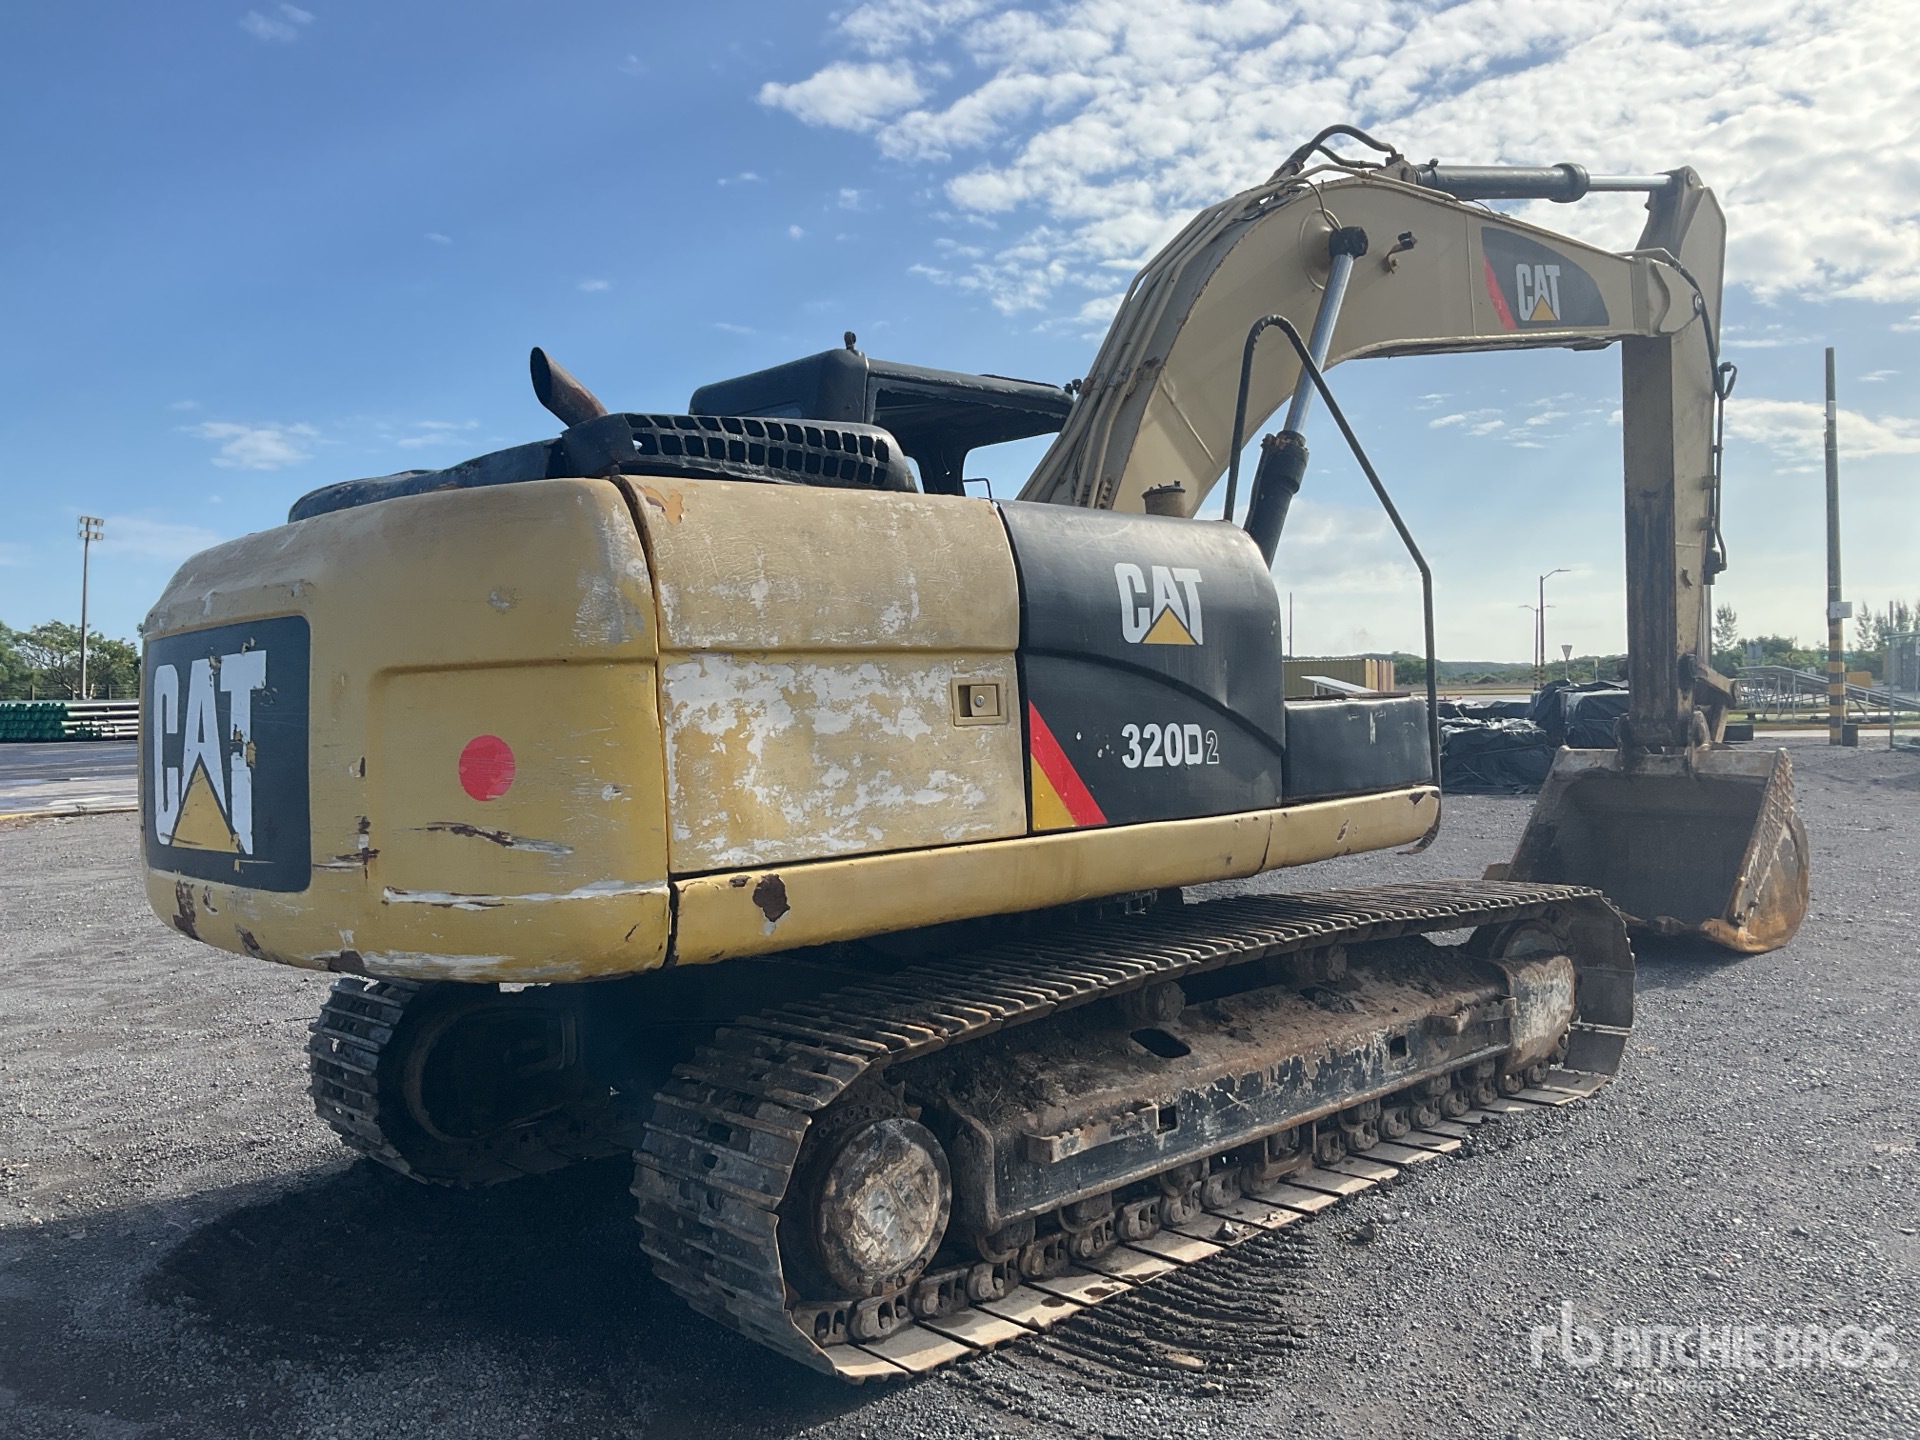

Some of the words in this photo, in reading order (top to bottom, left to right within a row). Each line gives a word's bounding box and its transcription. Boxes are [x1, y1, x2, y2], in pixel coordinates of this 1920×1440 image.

[1515, 263, 1561, 321] CAT
[1114, 562, 1204, 646] CAT
[153, 649, 267, 855] CAT
